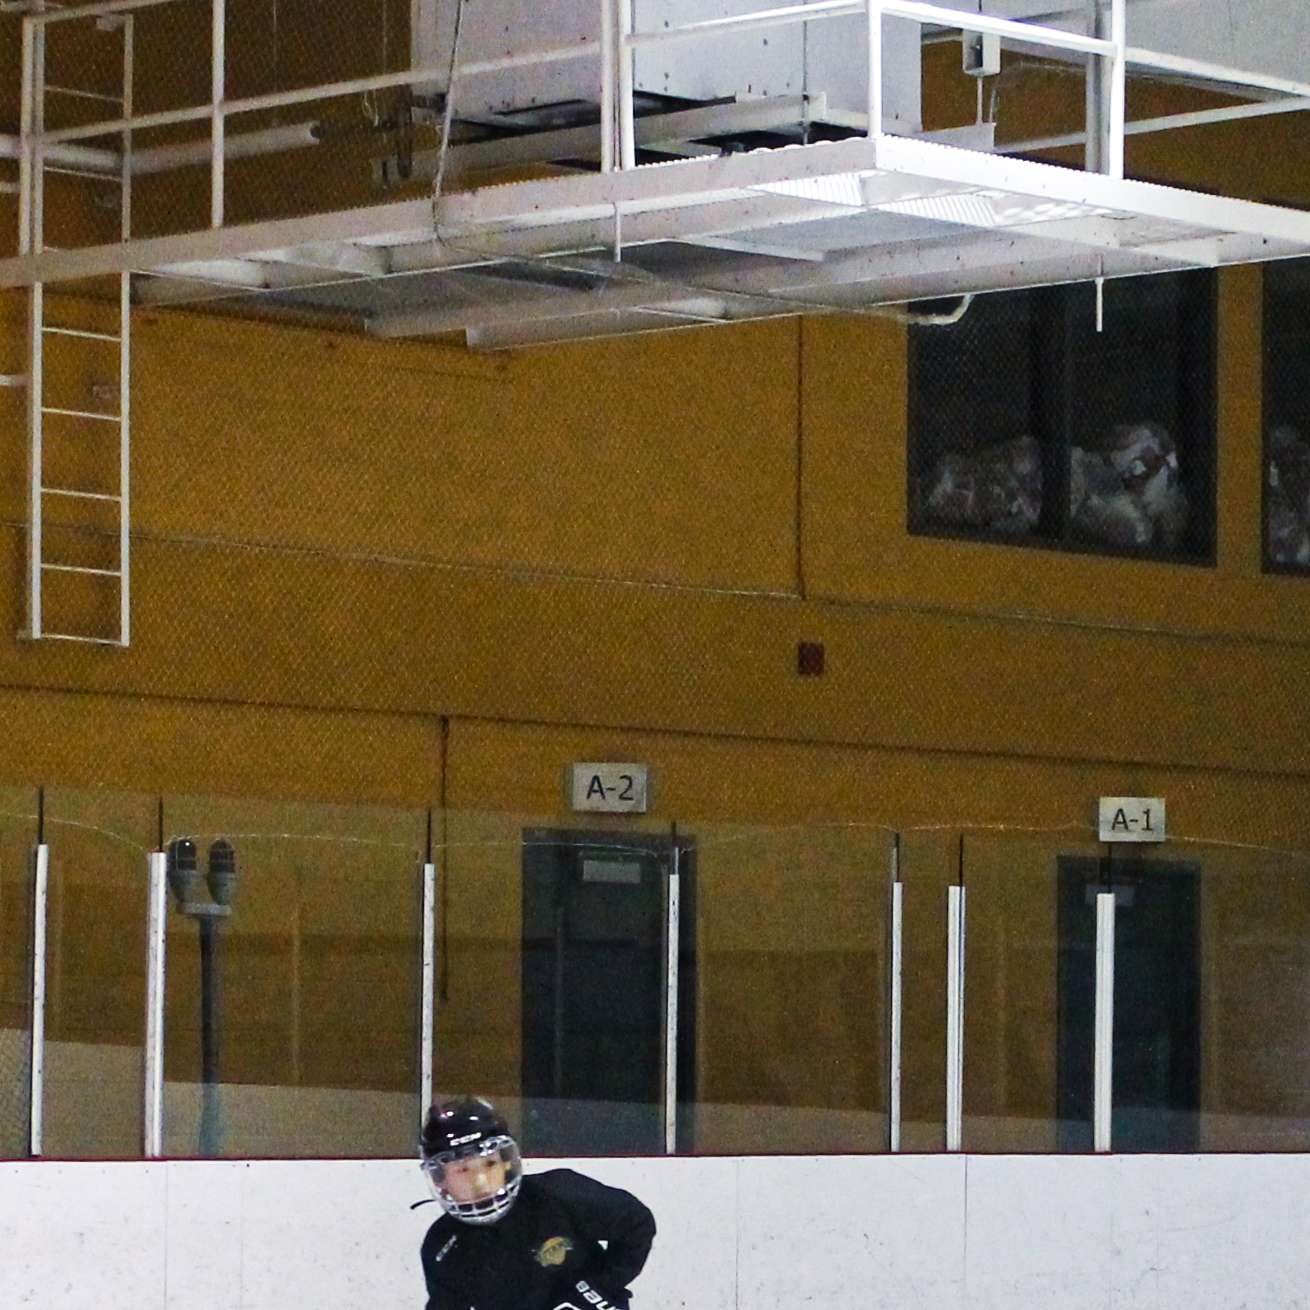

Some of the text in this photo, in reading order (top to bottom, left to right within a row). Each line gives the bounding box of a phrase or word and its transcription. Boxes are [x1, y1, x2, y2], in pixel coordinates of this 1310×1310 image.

[586, 774, 634, 801] A-2
[1112, 808, 1153, 831] A-1
[450, 1132, 482, 1146] CCM
